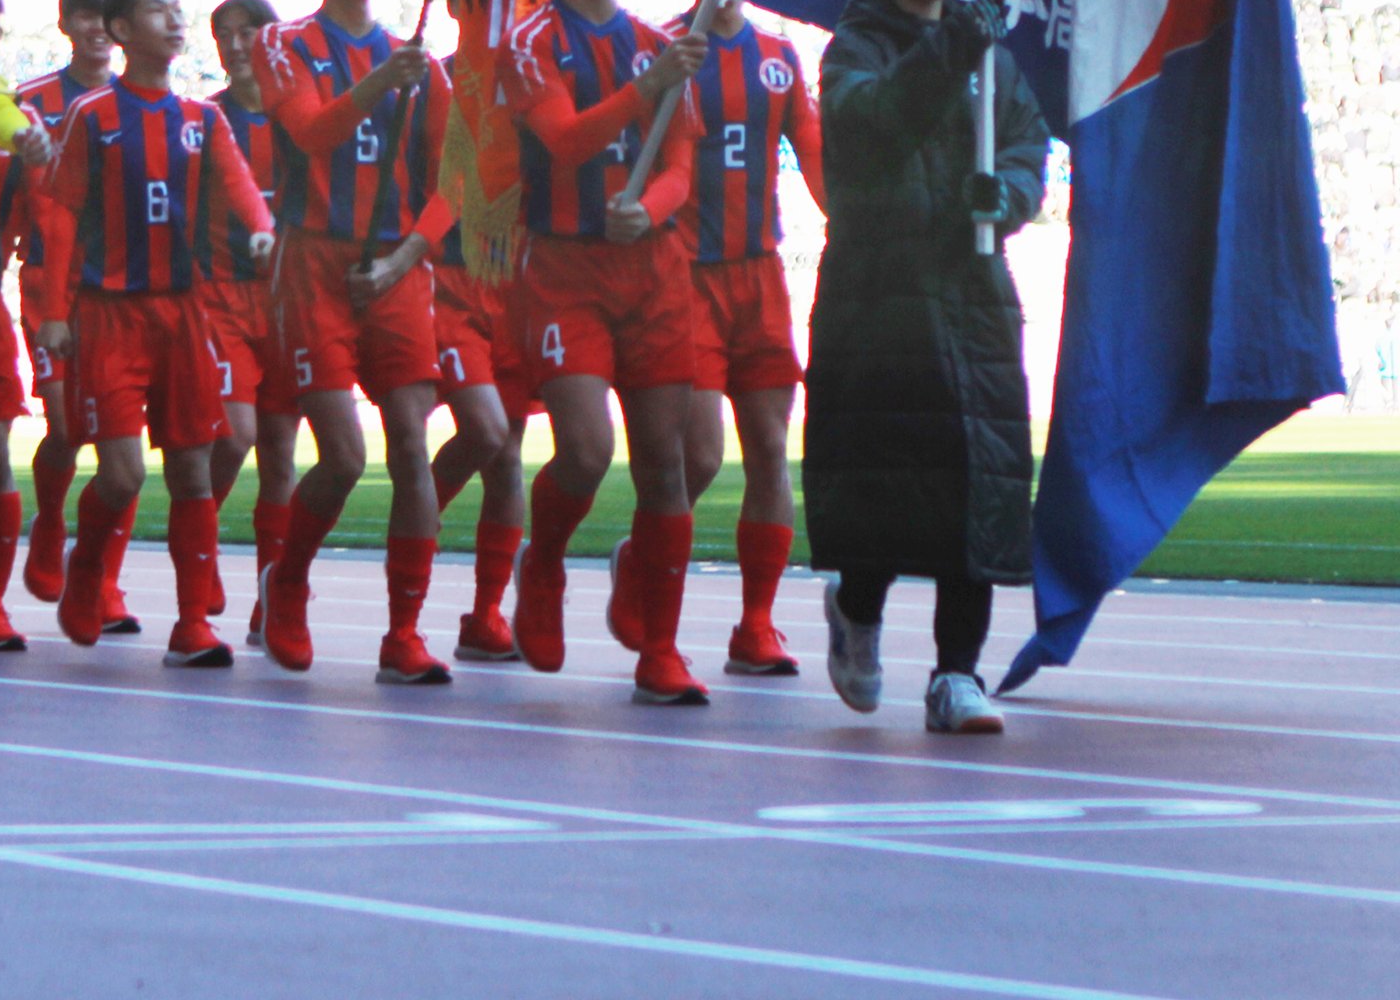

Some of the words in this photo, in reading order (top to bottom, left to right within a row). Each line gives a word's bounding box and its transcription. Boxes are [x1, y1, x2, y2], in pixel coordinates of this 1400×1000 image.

[356, 117, 379, 163] 5
[723, 124, 746, 168] 2
[541, 323, 566, 367] 4
[294, 348, 313, 388] 5
